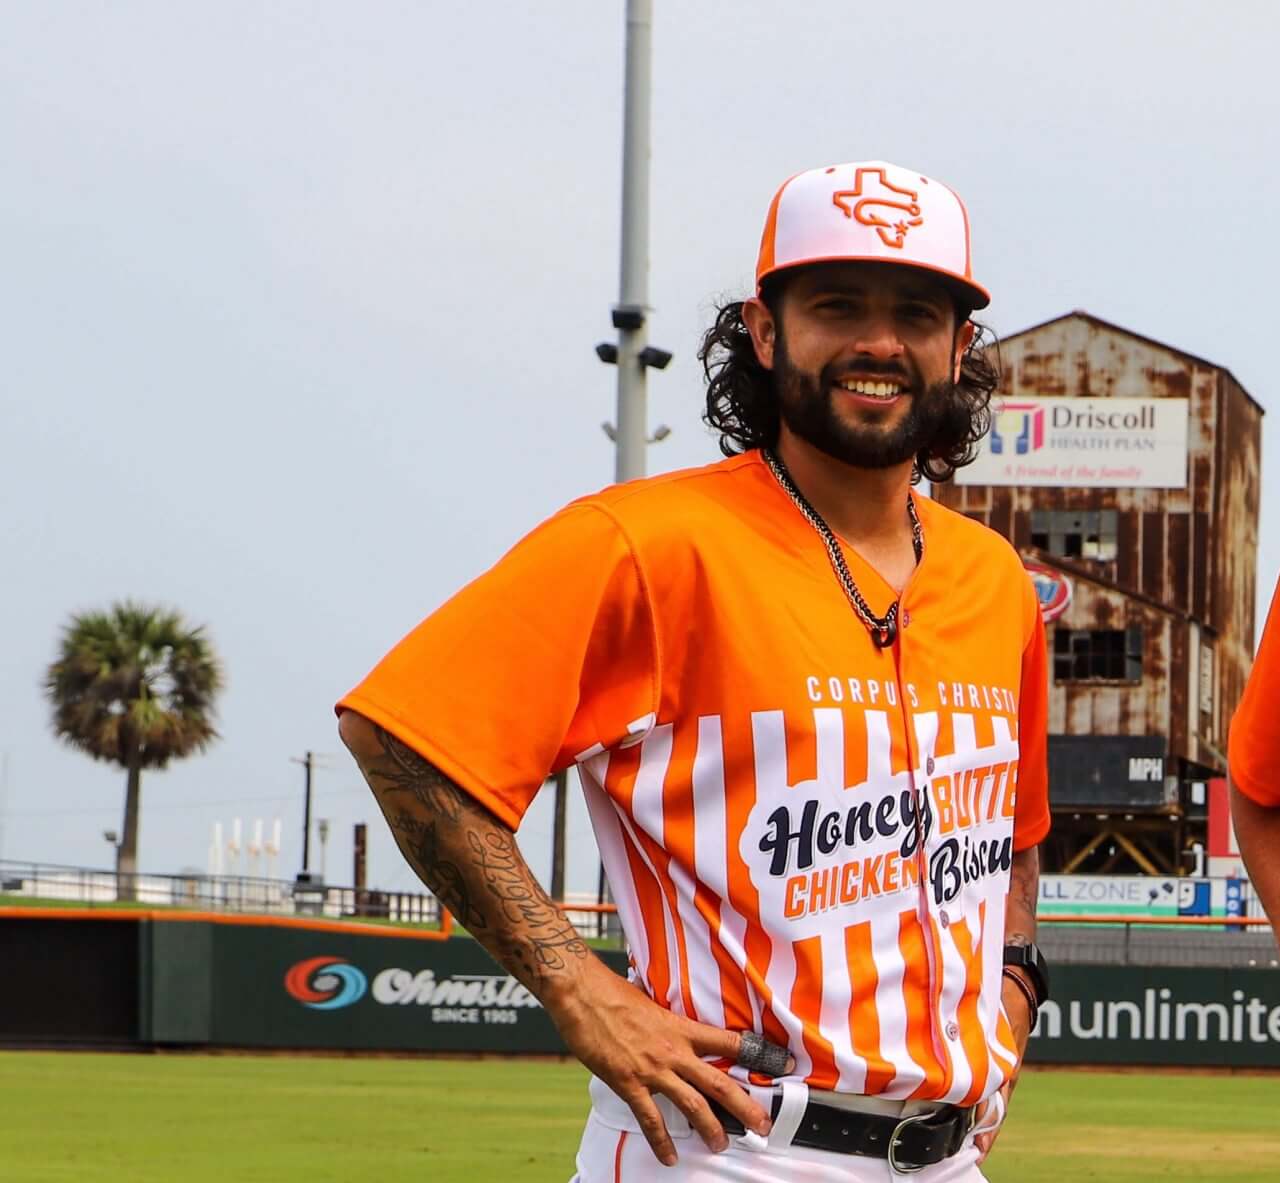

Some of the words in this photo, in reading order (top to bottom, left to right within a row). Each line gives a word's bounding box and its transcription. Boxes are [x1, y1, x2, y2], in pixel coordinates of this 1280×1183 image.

[1052, 405, 1155, 429] Driscoll
[1050, 437, 1109, 450] HEALTH
[1114, 438, 1156, 450] PLAN
[806, 676, 920, 708] CORPUS
[1129, 758, 1163, 781] MPH
[759, 784, 933, 876] Honey
[931, 760, 1018, 836] BUTTE
[783, 850, 928, 919] CHICKEN
[1074, 882, 1141, 900] ZONE
[432, 1008, 478, 1023] SINCE
[483, 1010, 518, 1024] 1905
